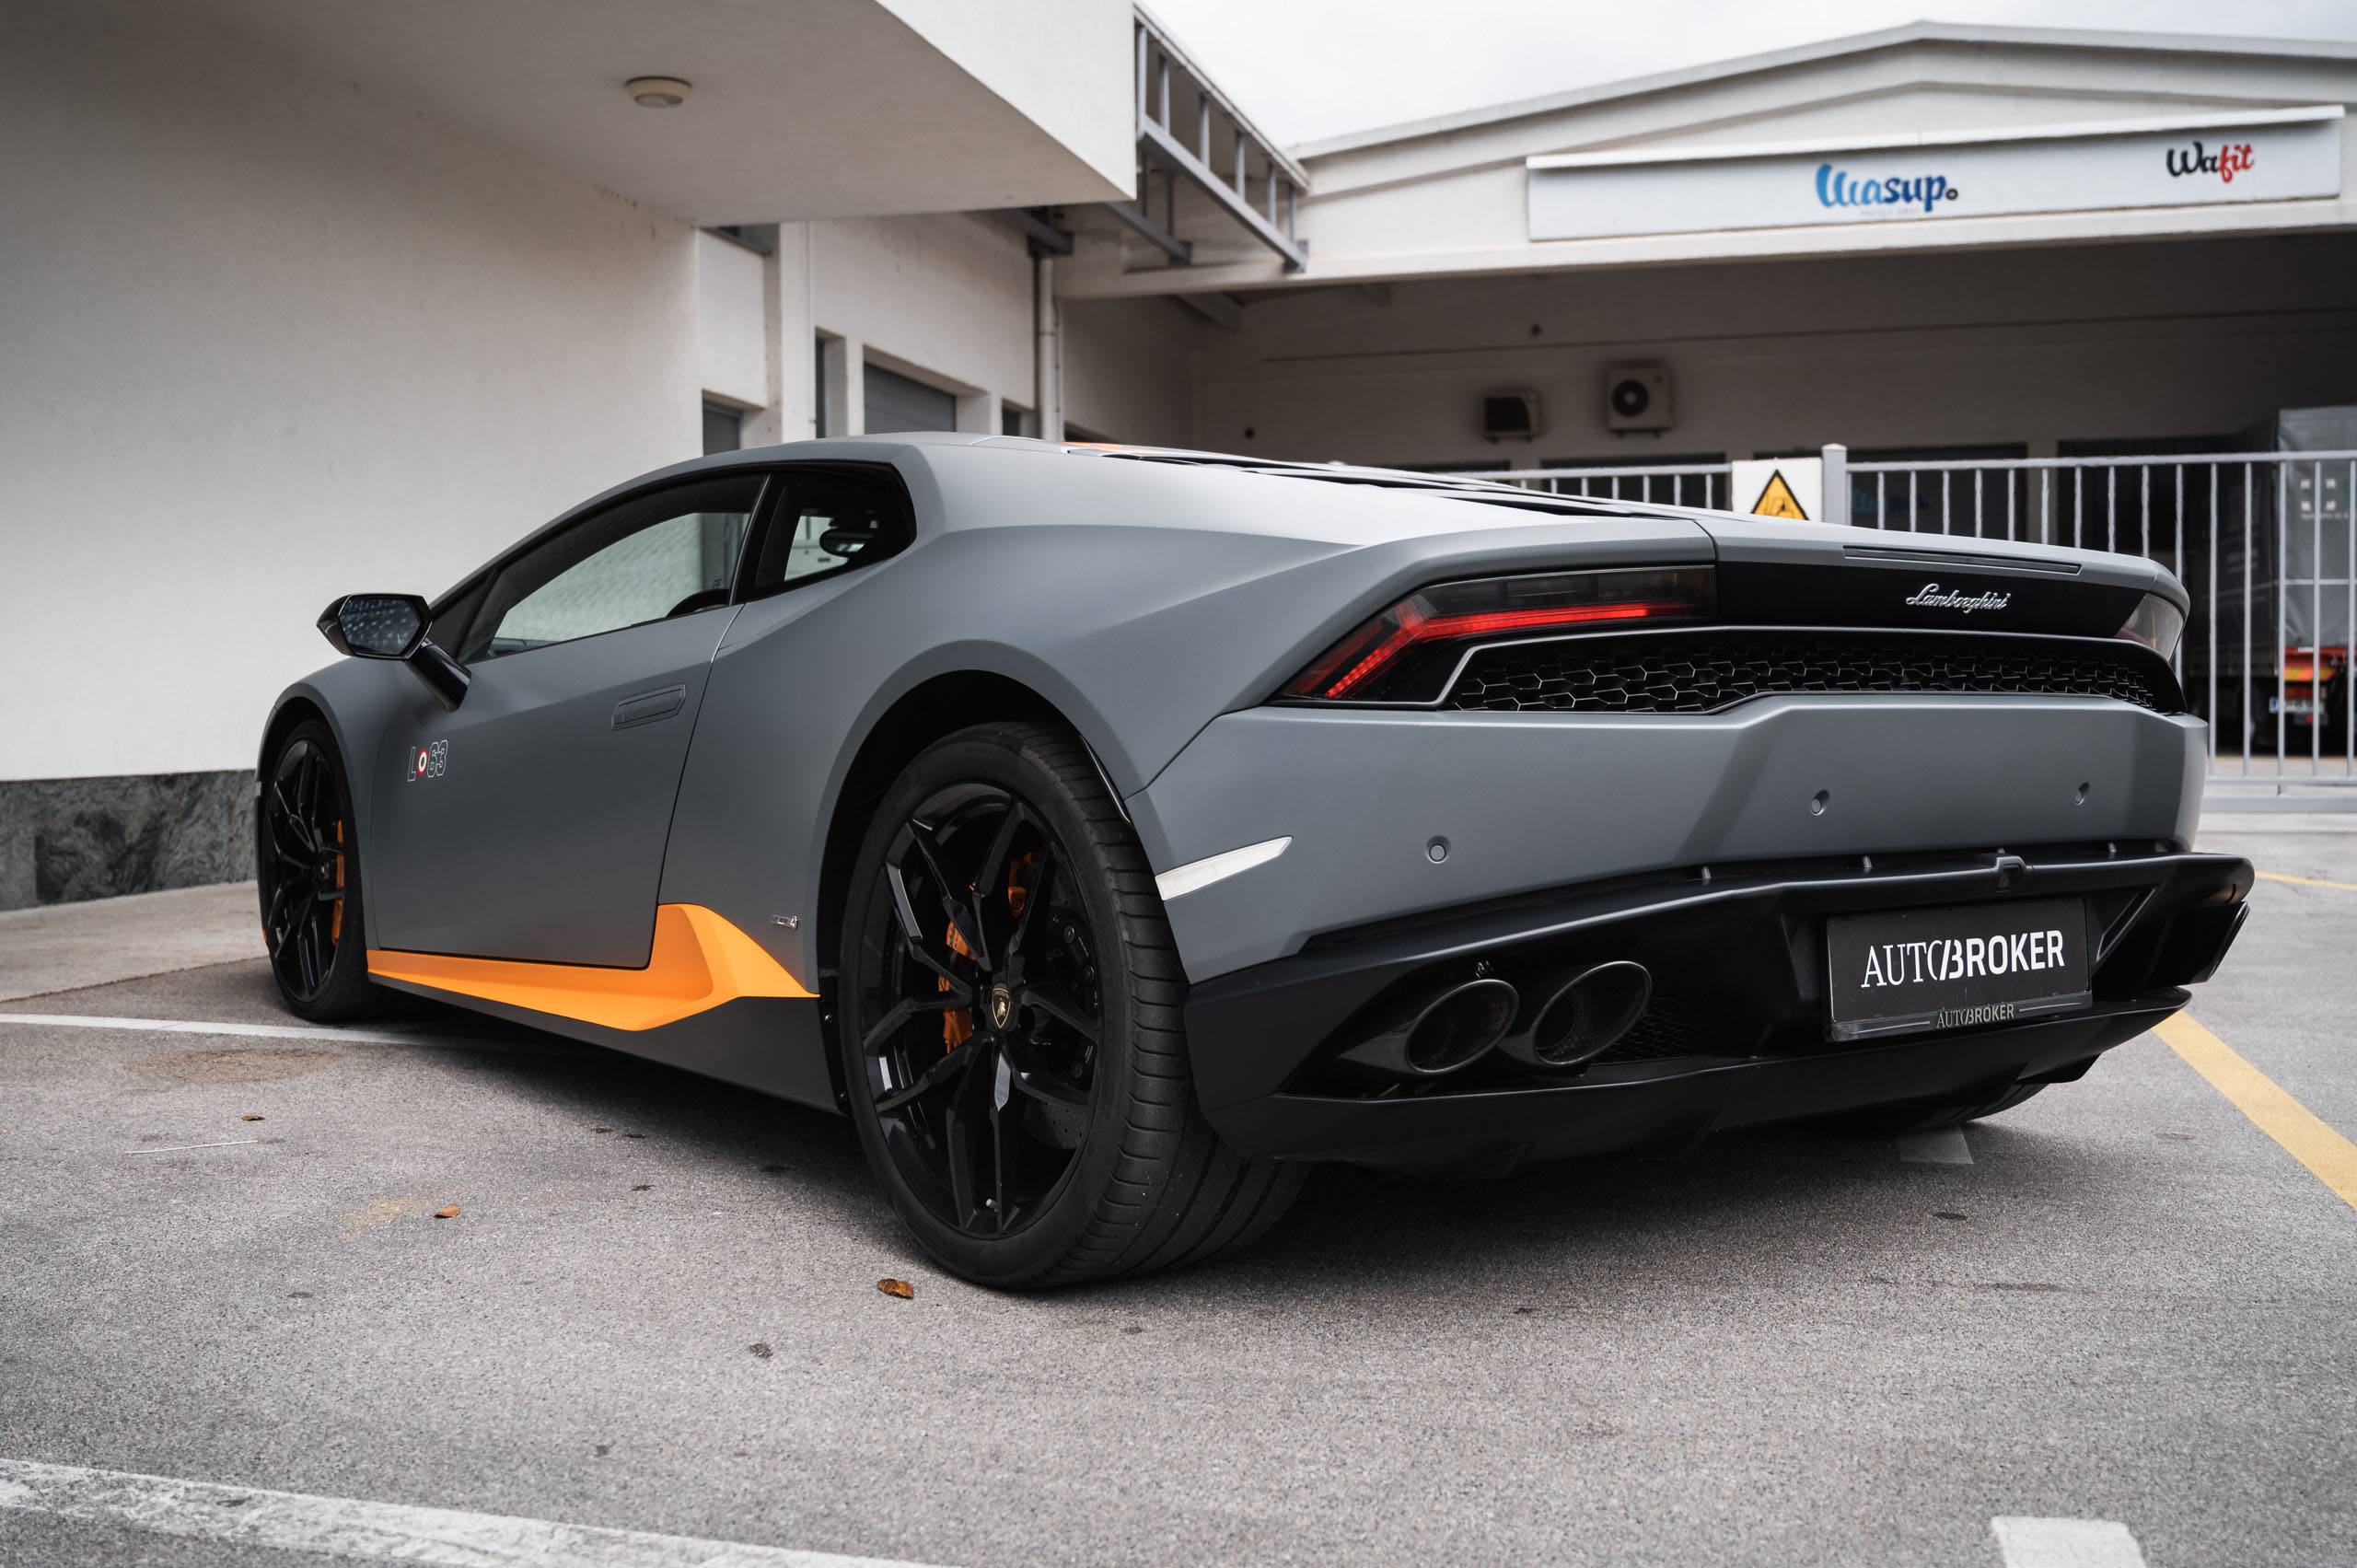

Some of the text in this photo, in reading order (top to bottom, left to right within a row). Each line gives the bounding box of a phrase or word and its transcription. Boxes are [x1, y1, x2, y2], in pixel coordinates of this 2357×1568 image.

[1906, 583, 2011, 614] Lamborghini
[1861, 929, 2065, 988] AUTOBROKER
[1936, 1003, 2014, 1029] AUTOBROKER
